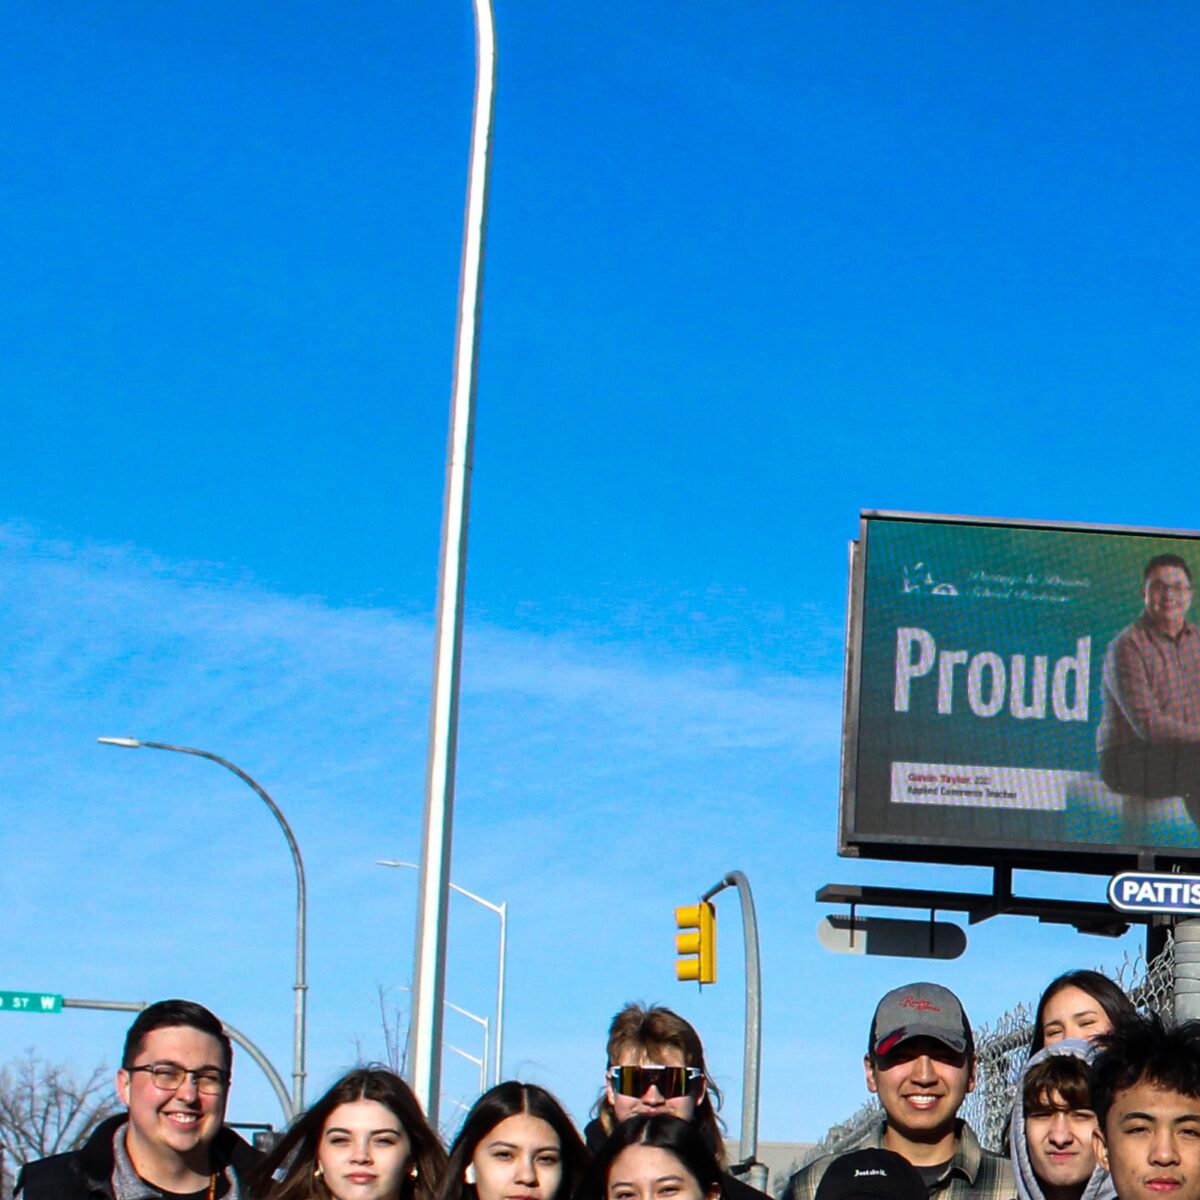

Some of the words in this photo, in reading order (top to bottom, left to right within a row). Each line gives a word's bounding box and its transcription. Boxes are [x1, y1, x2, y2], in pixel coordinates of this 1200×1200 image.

[894, 627, 1091, 722] Proud
[13, 997, 29, 1008] ST
[41, 996, 55, 1010] W
